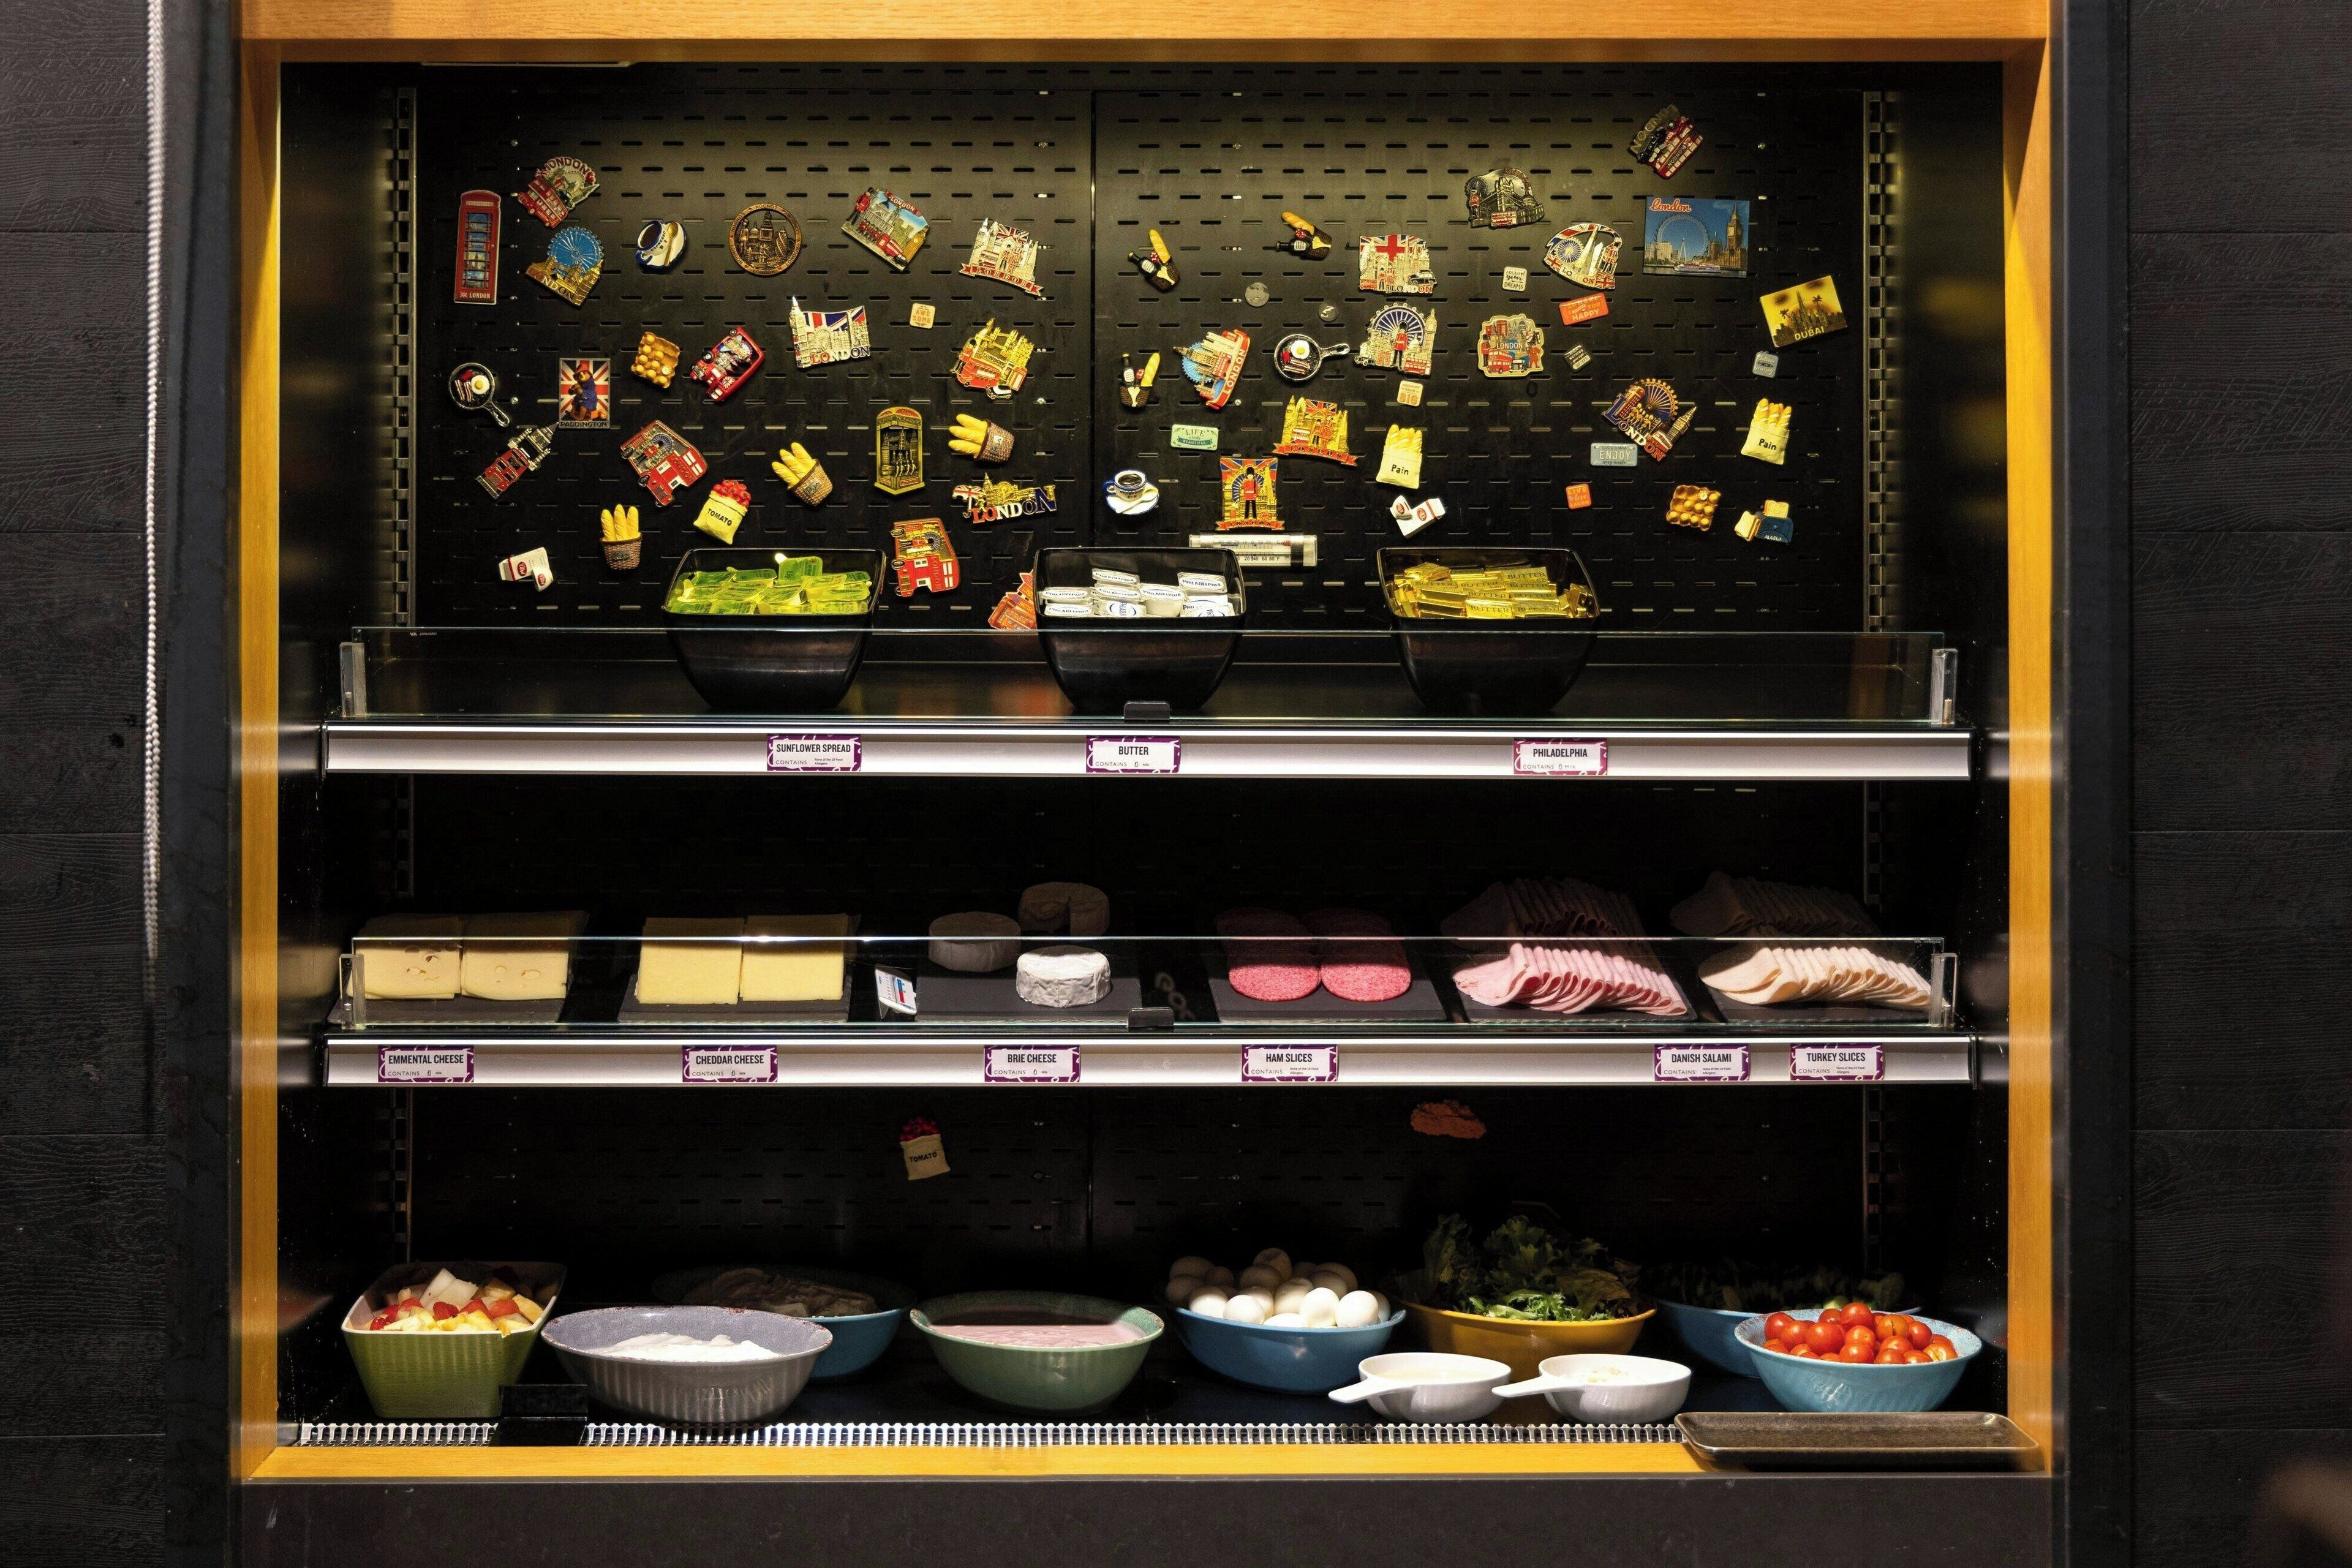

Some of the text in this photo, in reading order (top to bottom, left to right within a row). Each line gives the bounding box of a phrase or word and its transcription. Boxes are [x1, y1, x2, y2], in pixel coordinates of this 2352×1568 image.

[890, 196, 915, 212] LONDON
[1650, 197, 1692, 213] London
[978, 268, 1027, 287] LONDON
[912, 315, 930, 323] SOME
[1572, 309, 1600, 322] HAPPY
[1794, 326, 1825, 341] DUBAI
[810, 345, 871, 364] LONDON
[983, 352, 1005, 368] LONDON
[1224, 349, 1246, 394] LONDON
[1398, 392, 1419, 405] BIG
[1602, 393, 1667, 462] LONDON
[1758, 438, 1776, 451] Pain
[1291, 447, 1342, 459] LONDON
[1599, 450, 1631, 461] ENJOY
[1391, 464, 1409, 475] Pain
[1568, 487, 1586, 496] LIVE
[971, 485, 1057, 524] LONDON
[707, 508, 733, 526] TOMATO
[932, 556, 940, 590] LONDON
[1119, 746, 1148, 755] BUTTER
[1533, 748, 1587, 757] PHILADELPHIA
[389, 1055, 464, 1064] EMMENTAL CHEESE
[696, 1055, 764, 1065] CHEDDAR CHEESE
[1008, 1054, 1057, 1063] BRIE CHEESE
[1266, 1054, 1313, 1062] HAM SLICES
[1672, 1054, 1731, 1063] DANISH SALAMI
[1807, 1053, 1866, 1061] TURKEY SLICES
[909, 1152, 938, 1163] TOMATO
